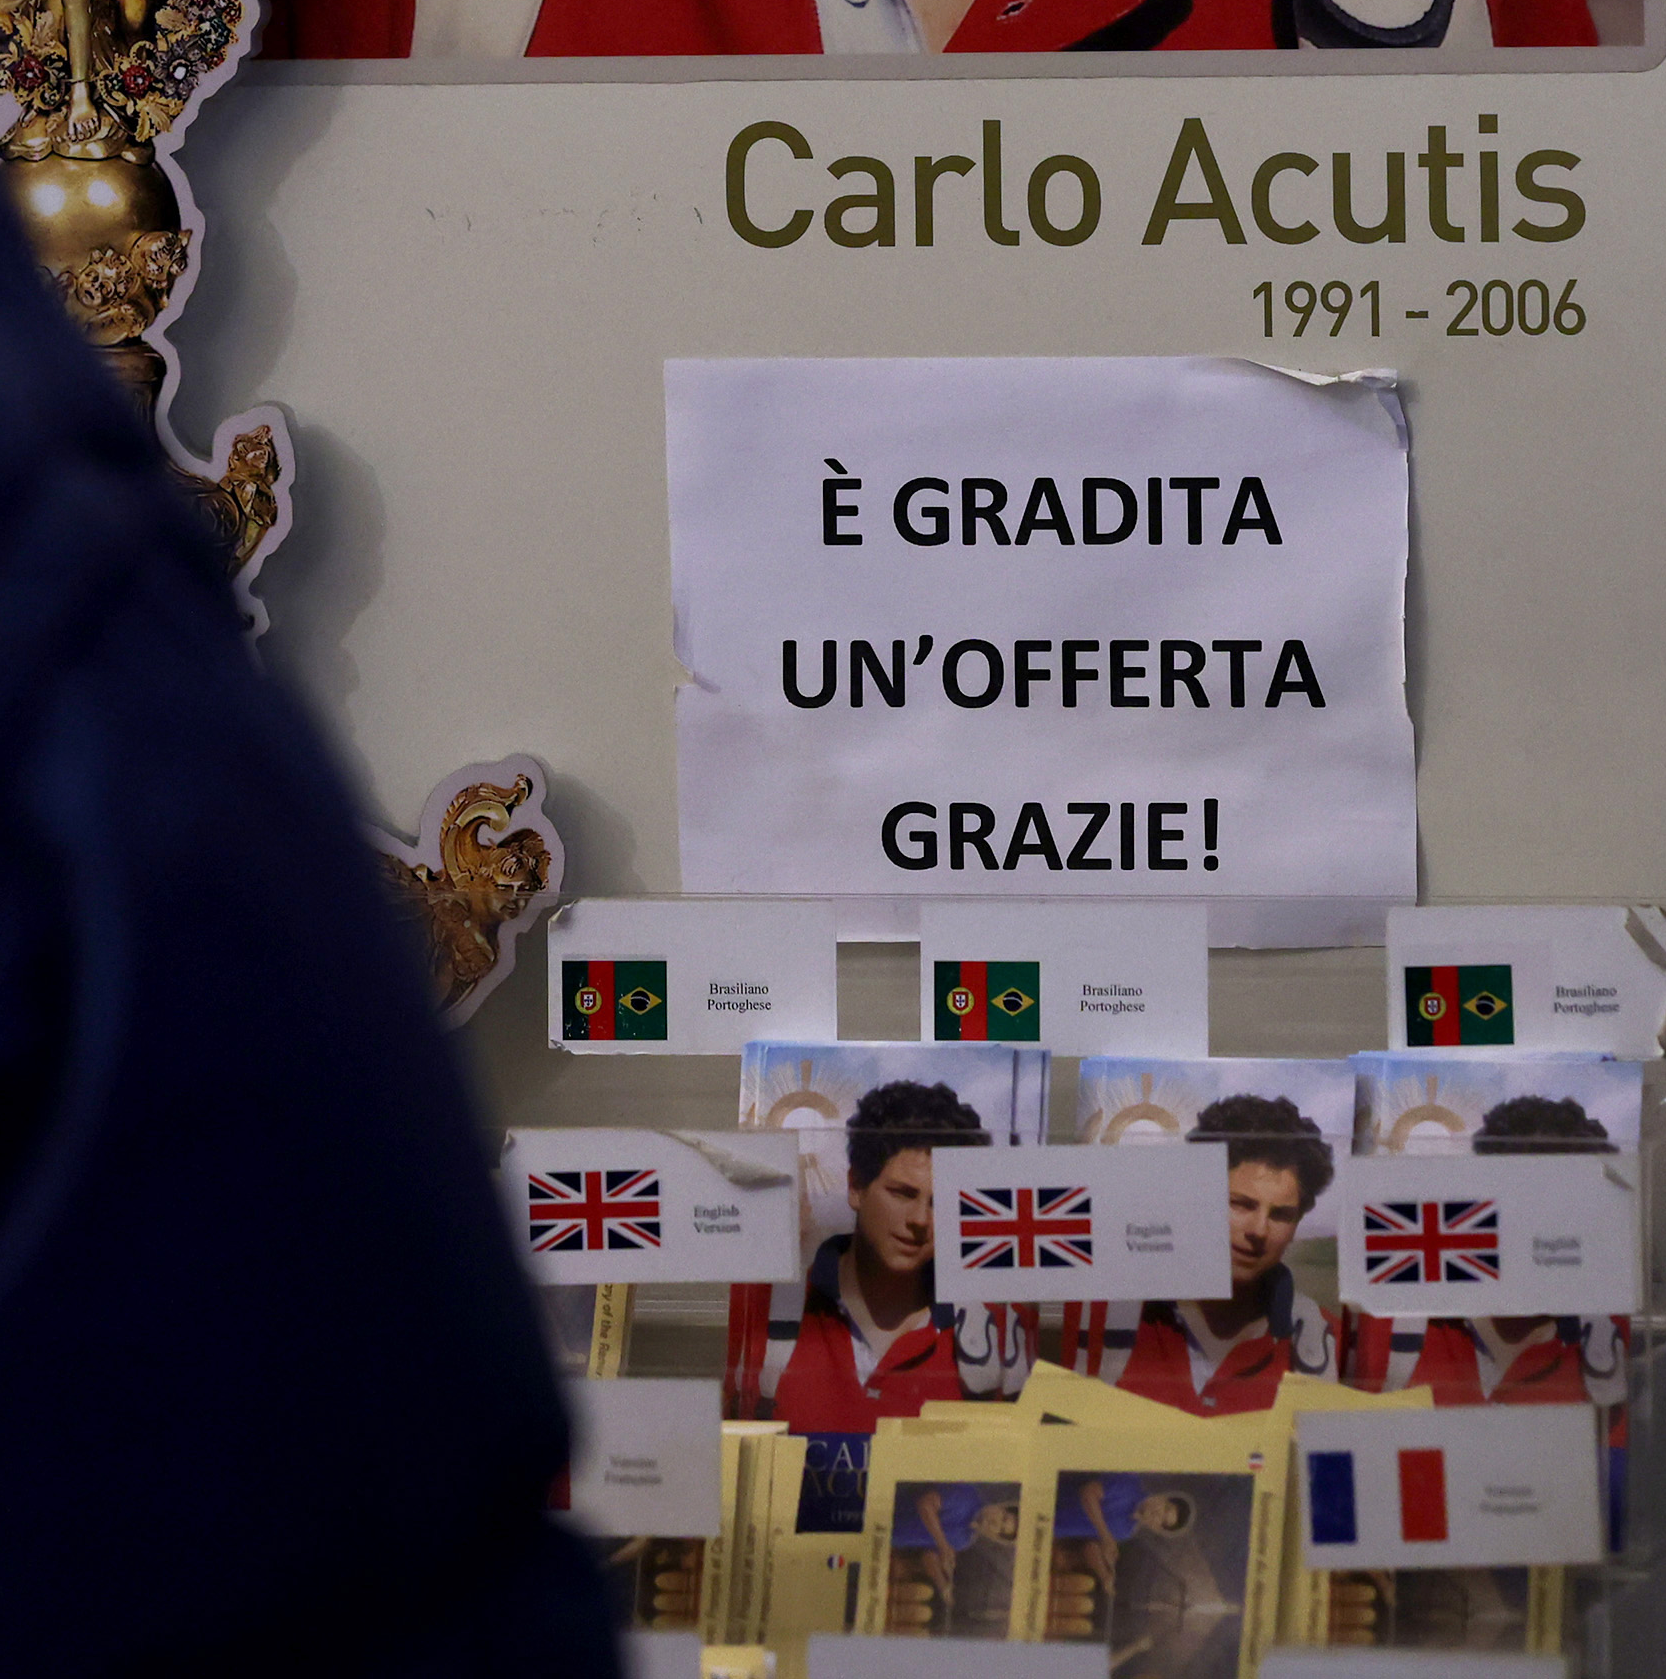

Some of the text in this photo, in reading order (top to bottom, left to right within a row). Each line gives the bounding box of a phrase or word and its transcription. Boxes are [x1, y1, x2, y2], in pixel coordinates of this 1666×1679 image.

[724, 112, 1587, 250] Carlo Acutis
[1252, 279, 1381, 339] 1991
[1444, 277, 1588, 338] 2006
[821, 457, 1284, 547] È GRADITA
[780, 632, 1327, 710] UN’OFFERTA
[879, 796, 1221, 872] GRAZIE!
[709, 982, 769, 995] Brasiliano
[1082, 984, 1143, 997] Brasiliano
[1555, 985, 1618, 998] Brasiliano
[707, 999, 772, 1014] Portoghese
[1080, 1000, 1146, 1015] Portoghese
[1554, 1001, 1620, 1017] Portoghese
[694, 1205, 740, 1221] English
[599, 1319, 613, 1340] the
